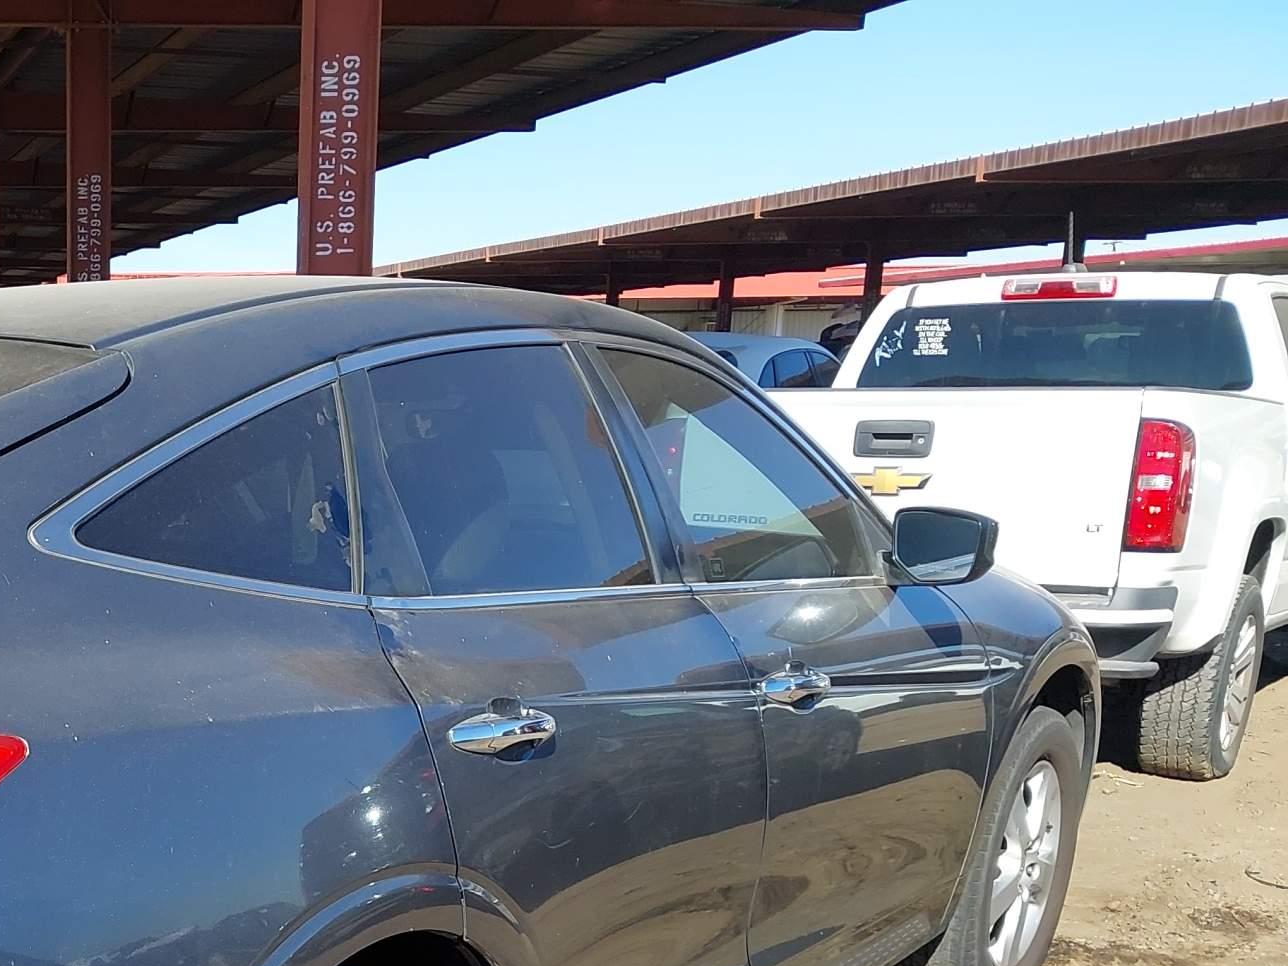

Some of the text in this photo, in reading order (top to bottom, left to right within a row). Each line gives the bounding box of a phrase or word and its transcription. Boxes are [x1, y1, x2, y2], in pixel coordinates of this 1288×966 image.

[316, 53, 340, 256] U.S. PREFAB INC.
[337, 55, 361, 254] 1-866-799-0969
[77, 207, 89, 260] PREFAB
[692, 513, 768, 525] COLORADO
[1086, 522, 1104, 533] LT
